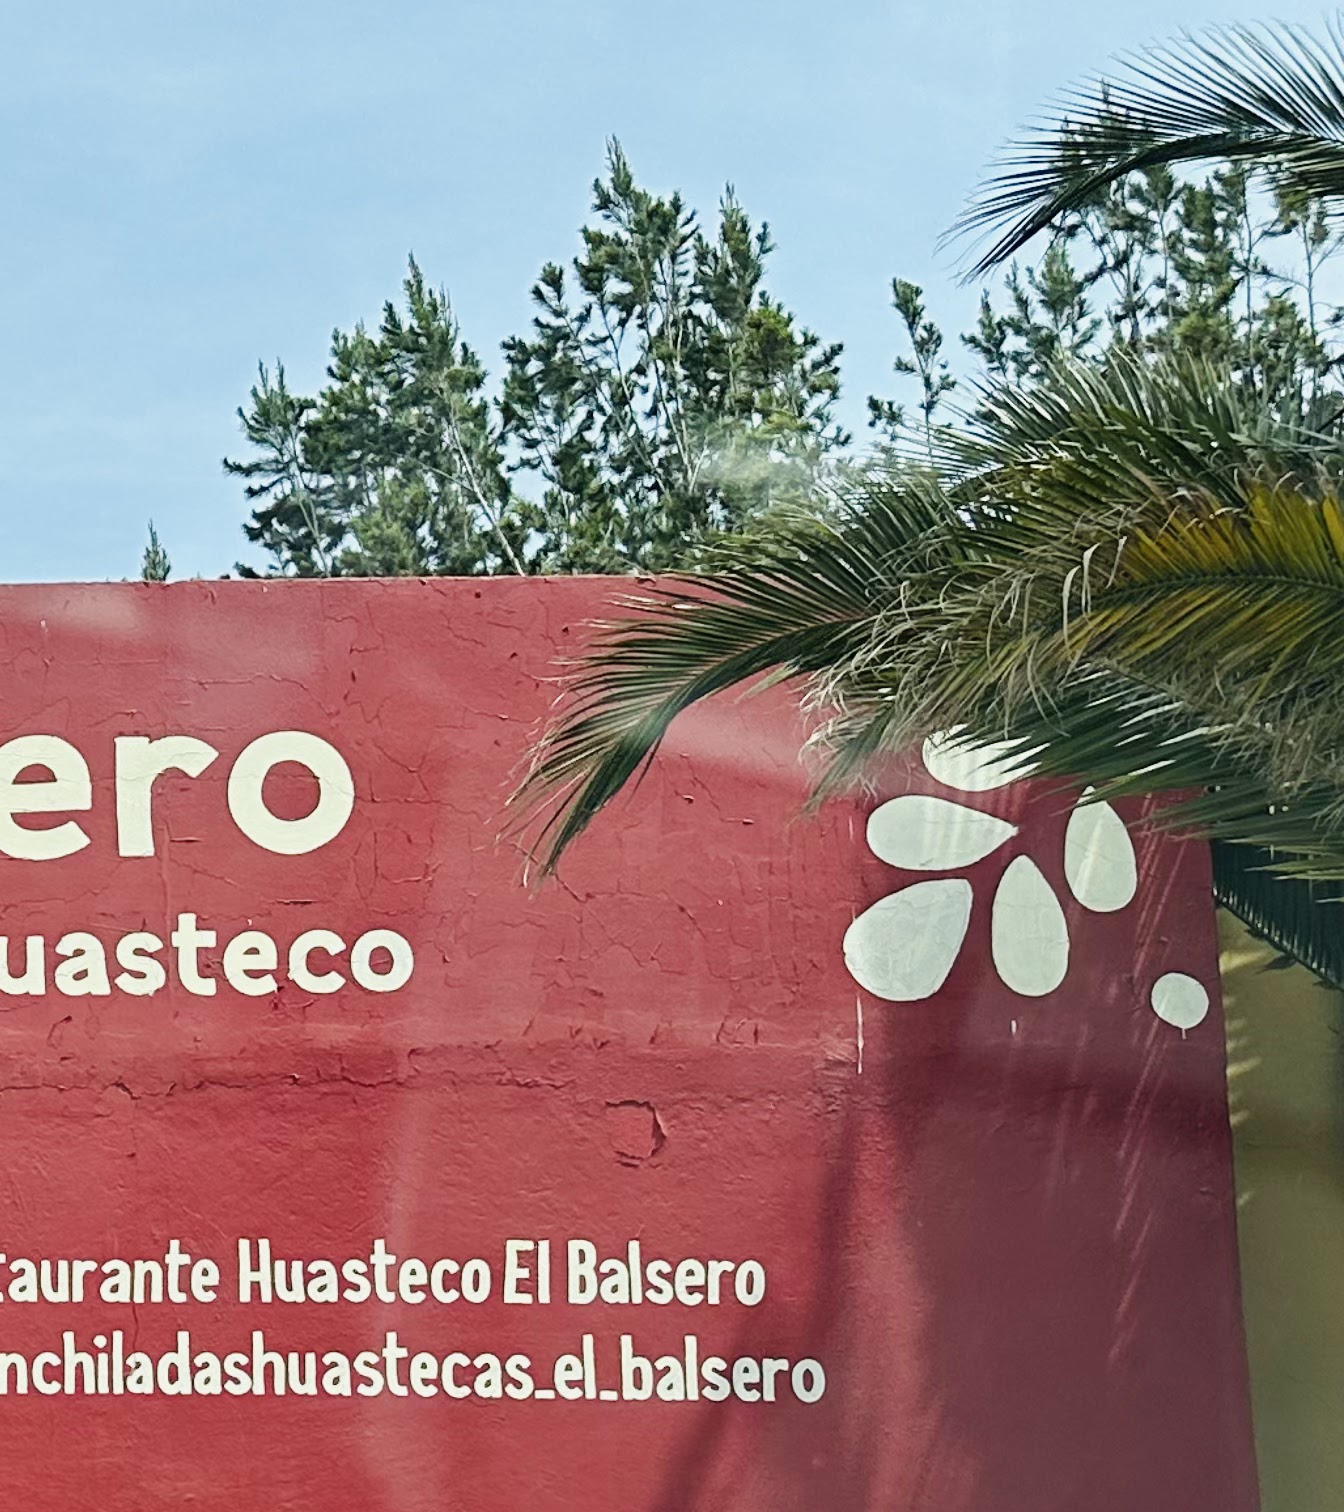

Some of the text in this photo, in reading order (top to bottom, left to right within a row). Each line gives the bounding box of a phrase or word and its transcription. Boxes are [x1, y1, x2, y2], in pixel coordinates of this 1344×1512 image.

[238, 1241, 490, 1305] Huasteco
[502, 1240, 550, 1305] El
[567, 1240, 766, 1307] Balsero
